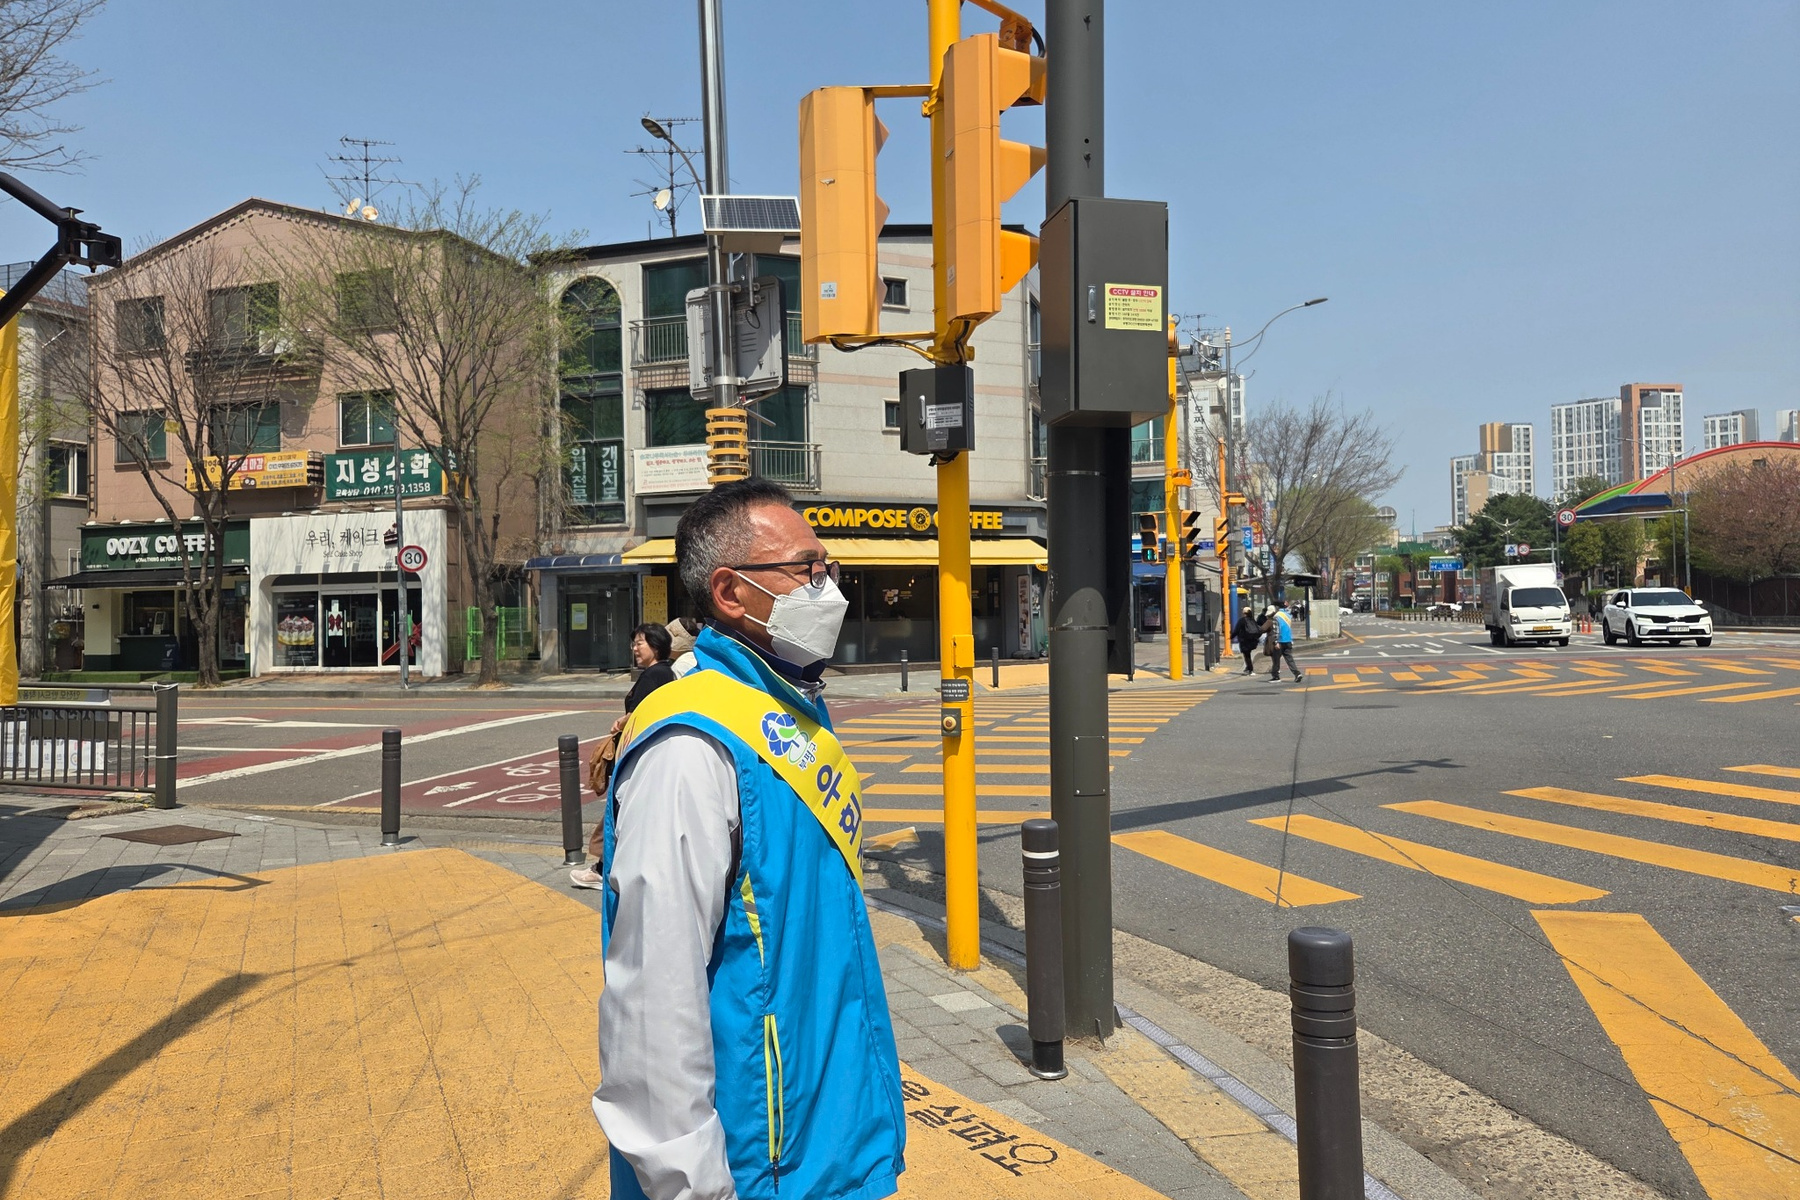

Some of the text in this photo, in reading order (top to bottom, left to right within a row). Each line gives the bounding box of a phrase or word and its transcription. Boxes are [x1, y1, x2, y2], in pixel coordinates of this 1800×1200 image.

[335, 453, 432, 484] 지성수학
[363, 482, 431, 496] 010.259.1358
[803, 507, 1003, 529] COMPOSE FEE
[1561, 513, 1572, 522] 30
[340, 527, 379, 546] 케이크
[106, 537, 149, 556] OOZY
[349, 550, 363, 558] Shop
[404, 552, 422, 565] 30
[799, 742, 817, 769] 부평구
[817, 764, 863, 862] 우회
[907, 1104, 1058, 1177] 살펴요
